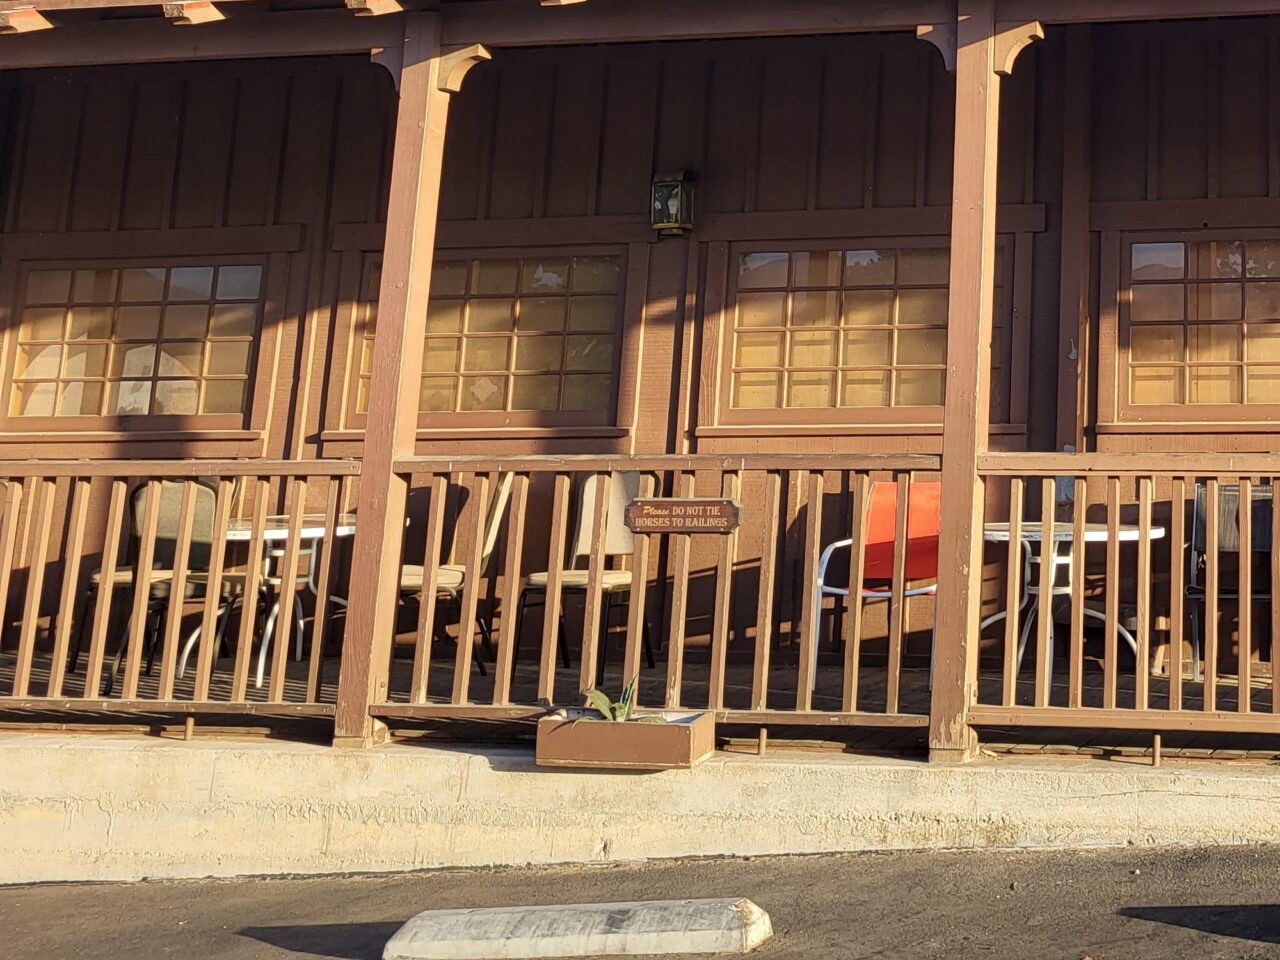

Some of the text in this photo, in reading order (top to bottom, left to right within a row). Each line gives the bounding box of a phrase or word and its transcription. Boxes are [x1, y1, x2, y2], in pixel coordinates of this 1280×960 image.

[642, 506, 721, 516] Please DO NOT TIE
[635, 517, 728, 527] HORSES TO RAILINGS
